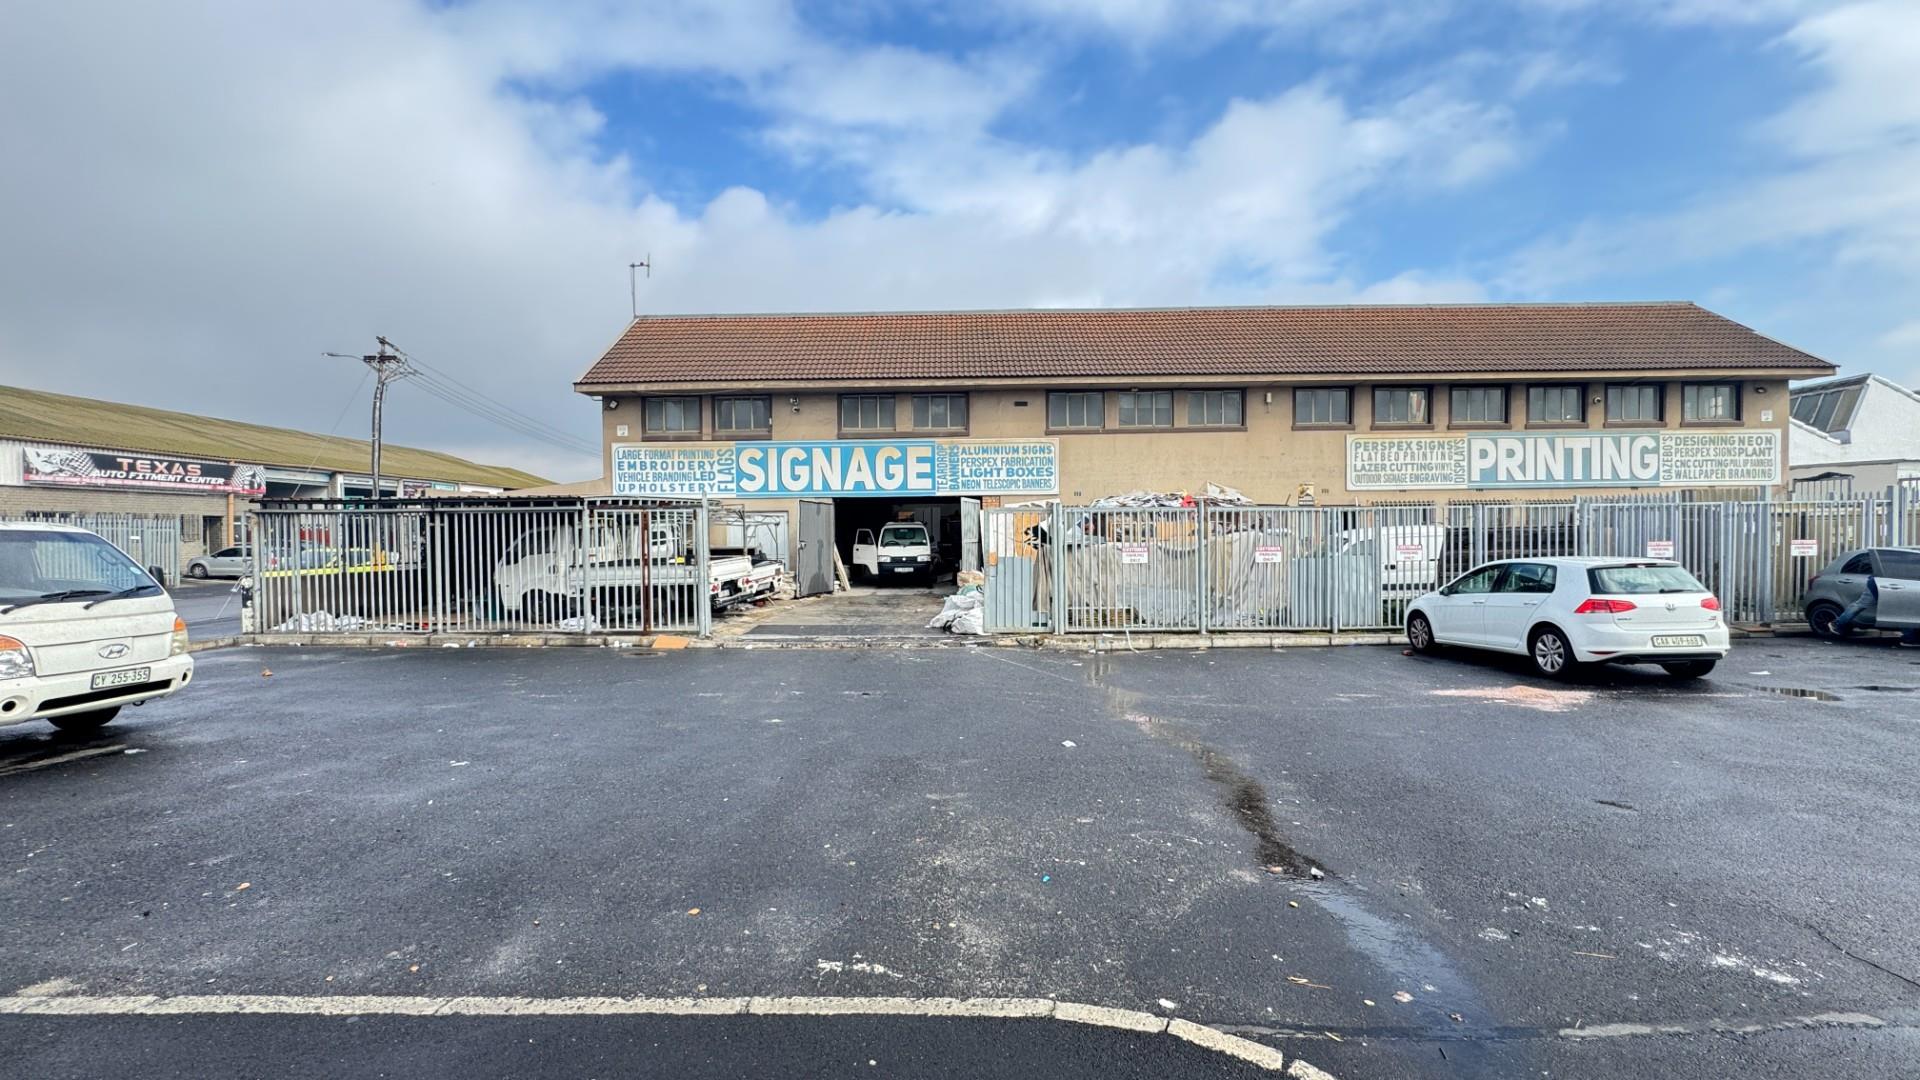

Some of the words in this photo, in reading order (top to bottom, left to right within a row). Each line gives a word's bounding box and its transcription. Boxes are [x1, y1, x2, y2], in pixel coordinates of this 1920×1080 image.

[1354, 441, 1413, 451] PERSPEX
[1415, 440, 1453, 451] SIGNS
[1674, 436, 1736, 447] DESIGNING
[1738, 436, 1773, 446] NEON
[617, 449, 642, 460] LARGE
[644, 449, 675, 460] FORMAT
[678, 449, 715, 460] PRINTING
[960, 445, 1020, 456] ALUMINIUM
[1022, 445, 1053, 455] SIGNS
[1674, 447, 1711, 458] PERSPEX
[1713, 447, 1737, 457] SIGNS
[1738, 447, 1773, 457] PLANT
[960, 457, 998, 467] PERSPEX
[1001, 456, 1054, 466] FABRICATION
[1354, 451, 1400, 462] FLATBED
[1403, 451, 1454, 462] PRINTING
[1454, 438, 1466, 483] DISPLAYS
[1470, 436, 1658, 481] PRINTING
[1662, 435, 1673, 480] GAZEBO'S
[116, 457, 202, 476] TEXAS
[617, 460, 716, 471] EMBROIDERY
[738, 446, 932, 492] SIGNAGE
[936, 445, 948, 491] TEARDROP
[949, 444, 960, 490] BANNERS
[1353, 463, 1387, 472] LAZER
[1389, 462, 1434, 472] CUTTING
[1435, 462, 1453, 472] VINYL
[1674, 459, 1692, 469] CNC
[1693, 459, 1729, 468] CUTTING
[716, 448, 735, 492] FLAGS
[960, 468, 1004, 478] LIGHT
[1006, 467, 1054, 477] BOXES
[1674, 469, 1726, 479] WALLPAPER
[1728, 468, 1773, 479] BRANDING
[93, 469, 127, 479] AUTO
[129, 471, 184, 483] FITMENT
[185, 475, 225, 485] CENTER
[617, 471, 651, 482] VEHICLE
[652, 471, 693, 482] BRANDING
[693, 471, 716, 481] LED
[1354, 473, 1382, 483] OUTDOOR
[1383, 473, 1409, 483] SIGNAGE
[1409, 472, 1453, 483] ENGRAVING
[618, 483, 716, 493] UPHOLSTERY
[960, 479, 981, 489] NEON
[983, 479, 1021, 489] TELESCOPIC
[1022, 478, 1053, 488] BANNERS
[94, 675, 106, 686] CY
[111, 670, 148, 684] 255-355
